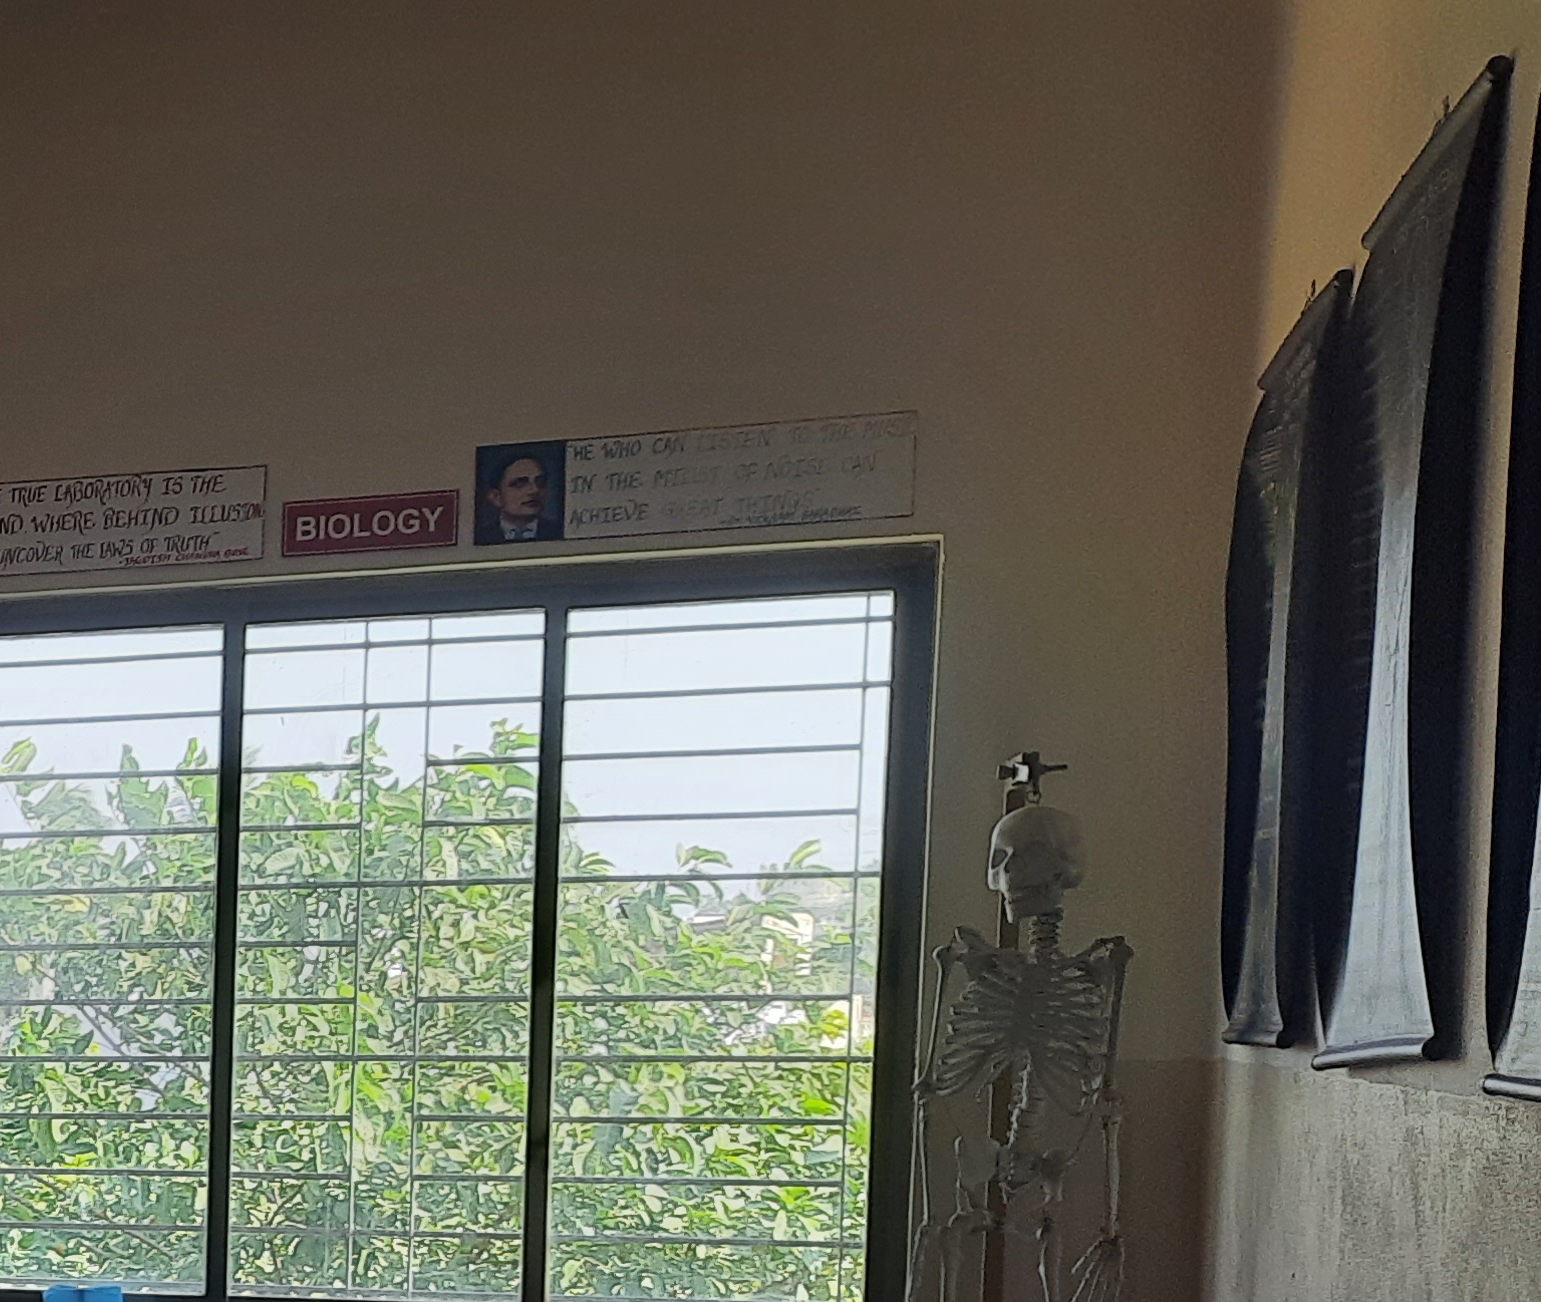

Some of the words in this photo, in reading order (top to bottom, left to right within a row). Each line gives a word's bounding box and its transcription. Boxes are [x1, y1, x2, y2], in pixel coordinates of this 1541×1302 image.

[602, 442, 641, 458] WHO
[653, 437, 685, 457] CAN
[9, 485, 47, 508] TRUE
[53, 478, 152, 509] LABORATORY
[161, 478, 183, 496] IS
[189, 474, 227, 494] THE
[569, 474, 595, 495] IN
[605, 470, 643, 490] THE
[101, 506, 179, 534] BEHIND
[296, 506, 444, 541] BIOLOGY
[569, 498, 649, 527] ACHIEVE
[71, 543, 93, 560] THE
[99, 539, 133, 559] LAWS
[139, 538, 157, 554] OF
